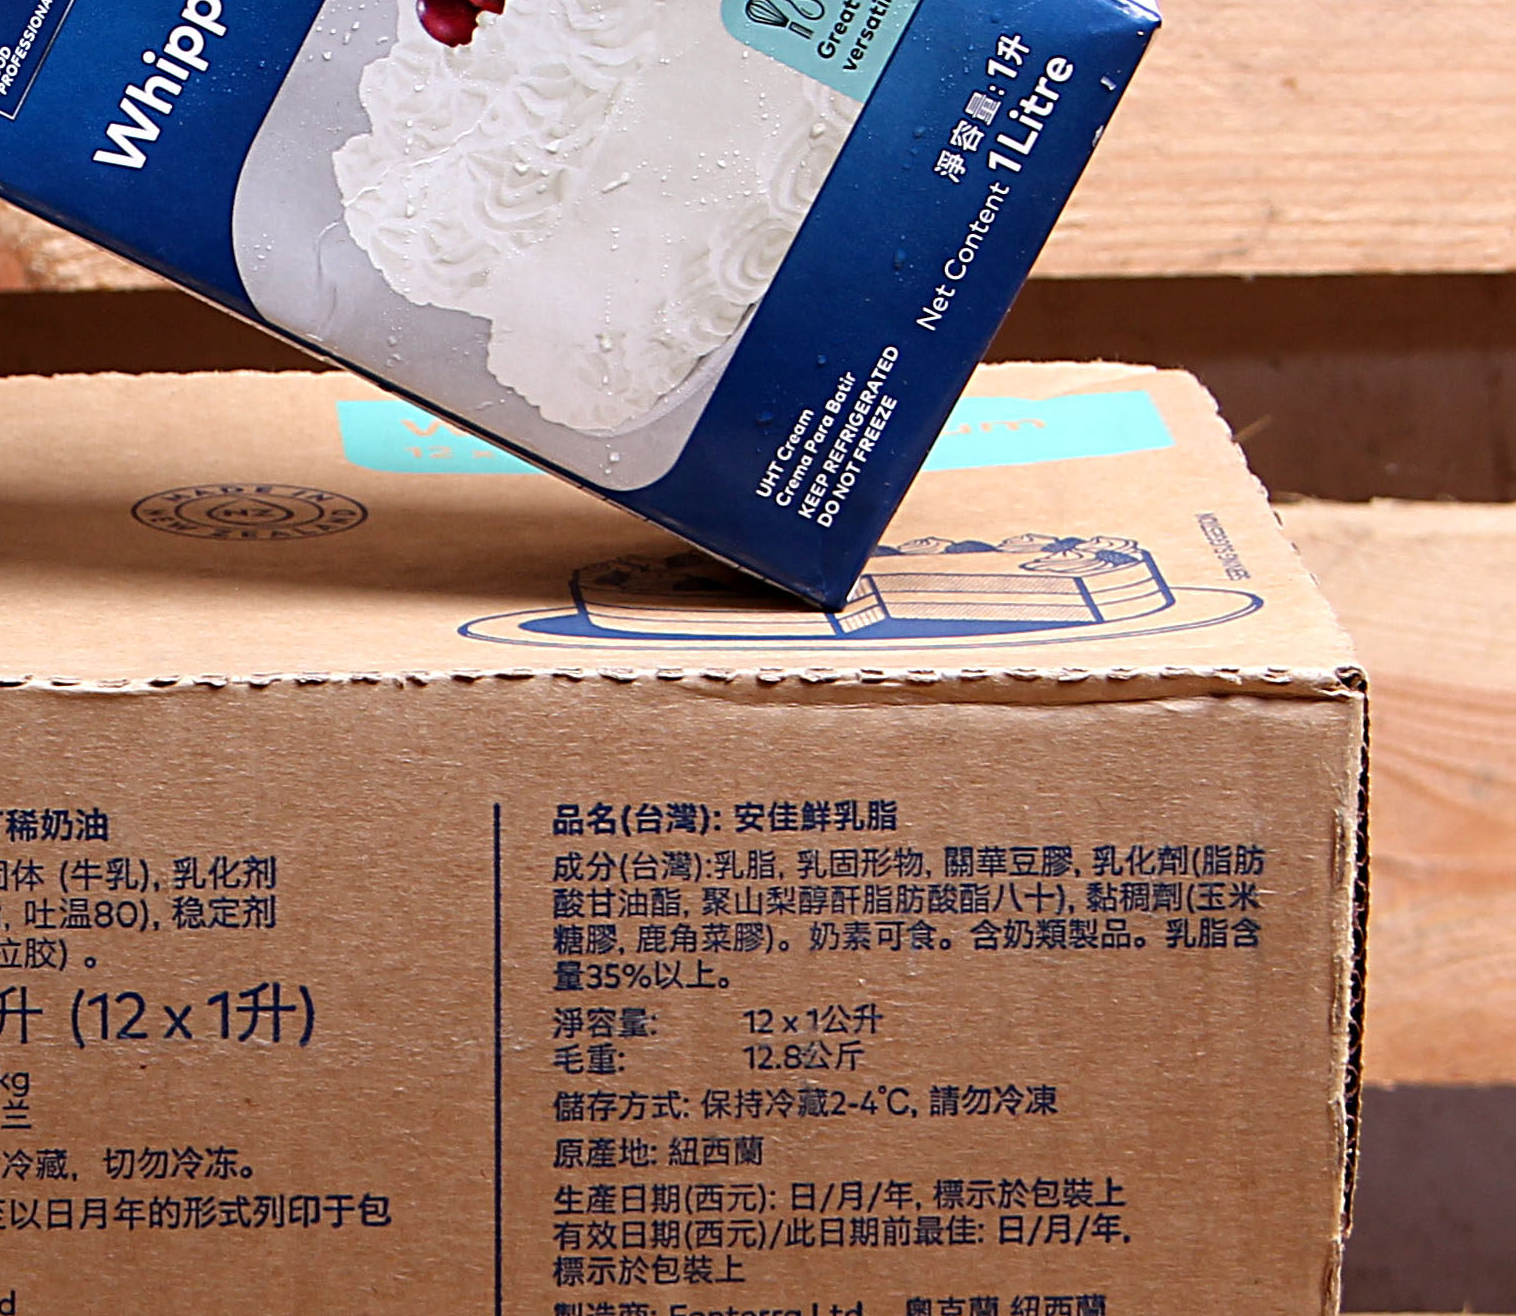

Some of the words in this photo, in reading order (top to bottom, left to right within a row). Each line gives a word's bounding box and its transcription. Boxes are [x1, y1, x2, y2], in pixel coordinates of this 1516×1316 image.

[916, 284, 957, 332] Net
[944, 181, 1011, 280] Content
[775, 454, 813, 507] Crema
[804, 415, 835, 454] Para
[825, 372, 857, 414] Batir
[798, 473, 830, 519] KEEP
[822, 346, 899, 474] REFRIGERATED
[756, 460, 785, 498] UHT
[776, 409, 815, 461] Cream
[816, 500, 841, 528] DO
[832, 461, 861, 500] NOT
[853, 394, 898, 463] FREEZE
[735, 800, 897, 832] 安佳鮮乳脂
[60, 858, 159, 893] (牛乳),
[173, 855, 276, 890] 乳化剂
[798, 847, 931, 879] 乳固形物,
[1093, 844, 1265, 877] 乳化劑(脂肪
[25, 898, 159, 932] 吐温80),
[172, 895, 276, 929] 稳定剂
[554, 924, 624, 955] 糖膠,
[72, 988, 148, 1049] (12
[163, 1005, 192, 1039] x
[207, 982, 315, 1047] 1升)
[554, 1008, 657, 1038] 淨容量:
[743, 1009, 773, 1034] 12
[783, 1016, 798, 1032] x
[807, 1003, 884, 1034] 1公升
[553, 1043, 624, 1074] 毛重:
[743, 1040, 865, 1071] 12.8公斤
[553, 1090, 689, 1121] 儲存方式:
[930, 1084, 1058, 1116] 請勿冷凍
[553, 1138, 657, 1168] 原產地:
[669, 1136, 764, 1165] 紐西蘭
[792, 1180, 921, 1212] 日/月/年,
[933, 1177, 1126, 1209] 標示於包裝上
[553, 1255, 745, 1286] 標示於包裝上
